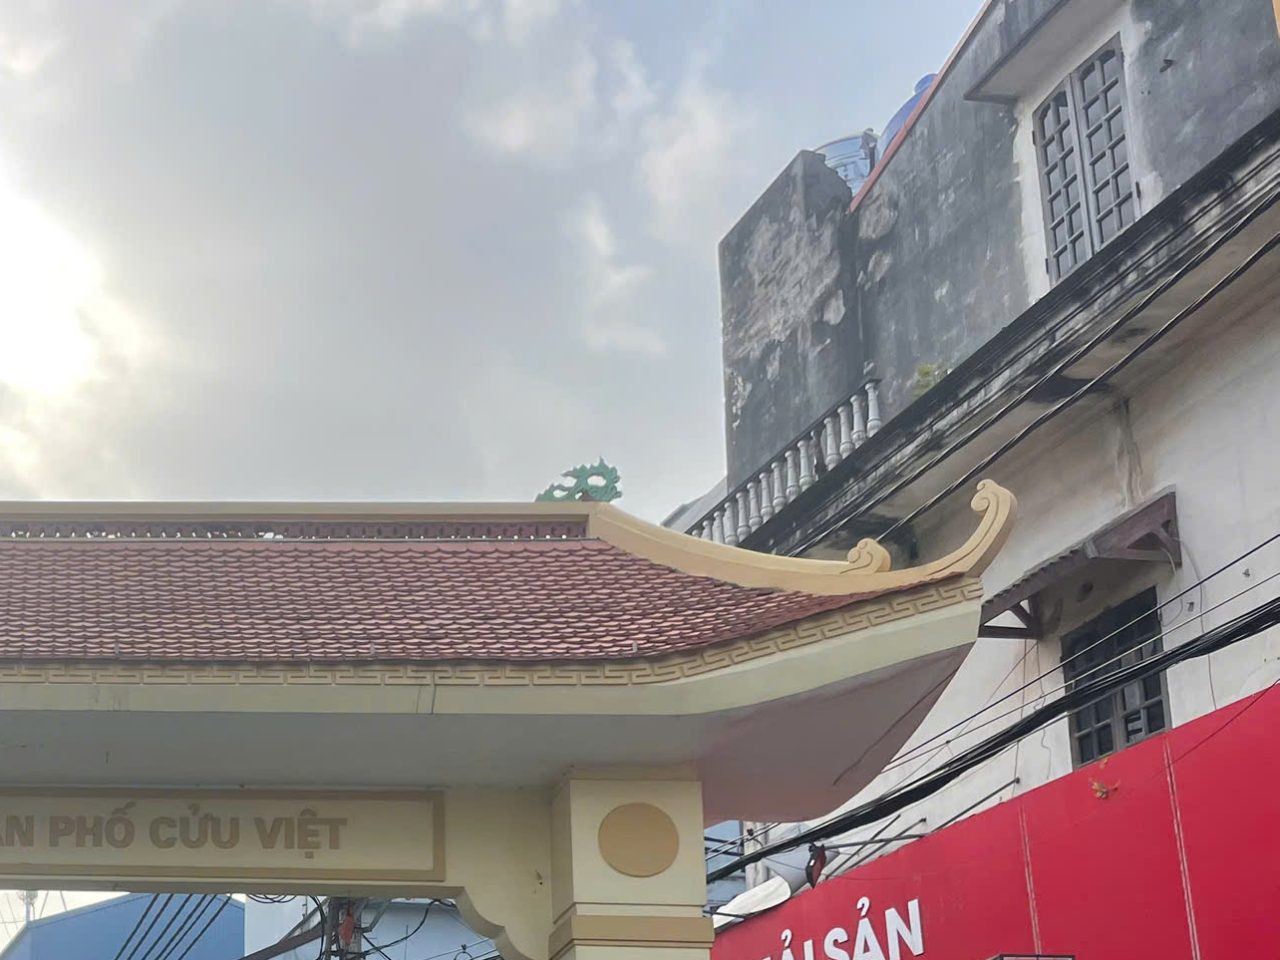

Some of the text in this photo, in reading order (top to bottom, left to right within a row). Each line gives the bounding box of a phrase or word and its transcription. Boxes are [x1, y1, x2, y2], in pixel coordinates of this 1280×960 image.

[48, 801, 137, 849] PHỐ
[149, 803, 241, 850] CỬU
[255, 807, 348, 860] VIỆT
